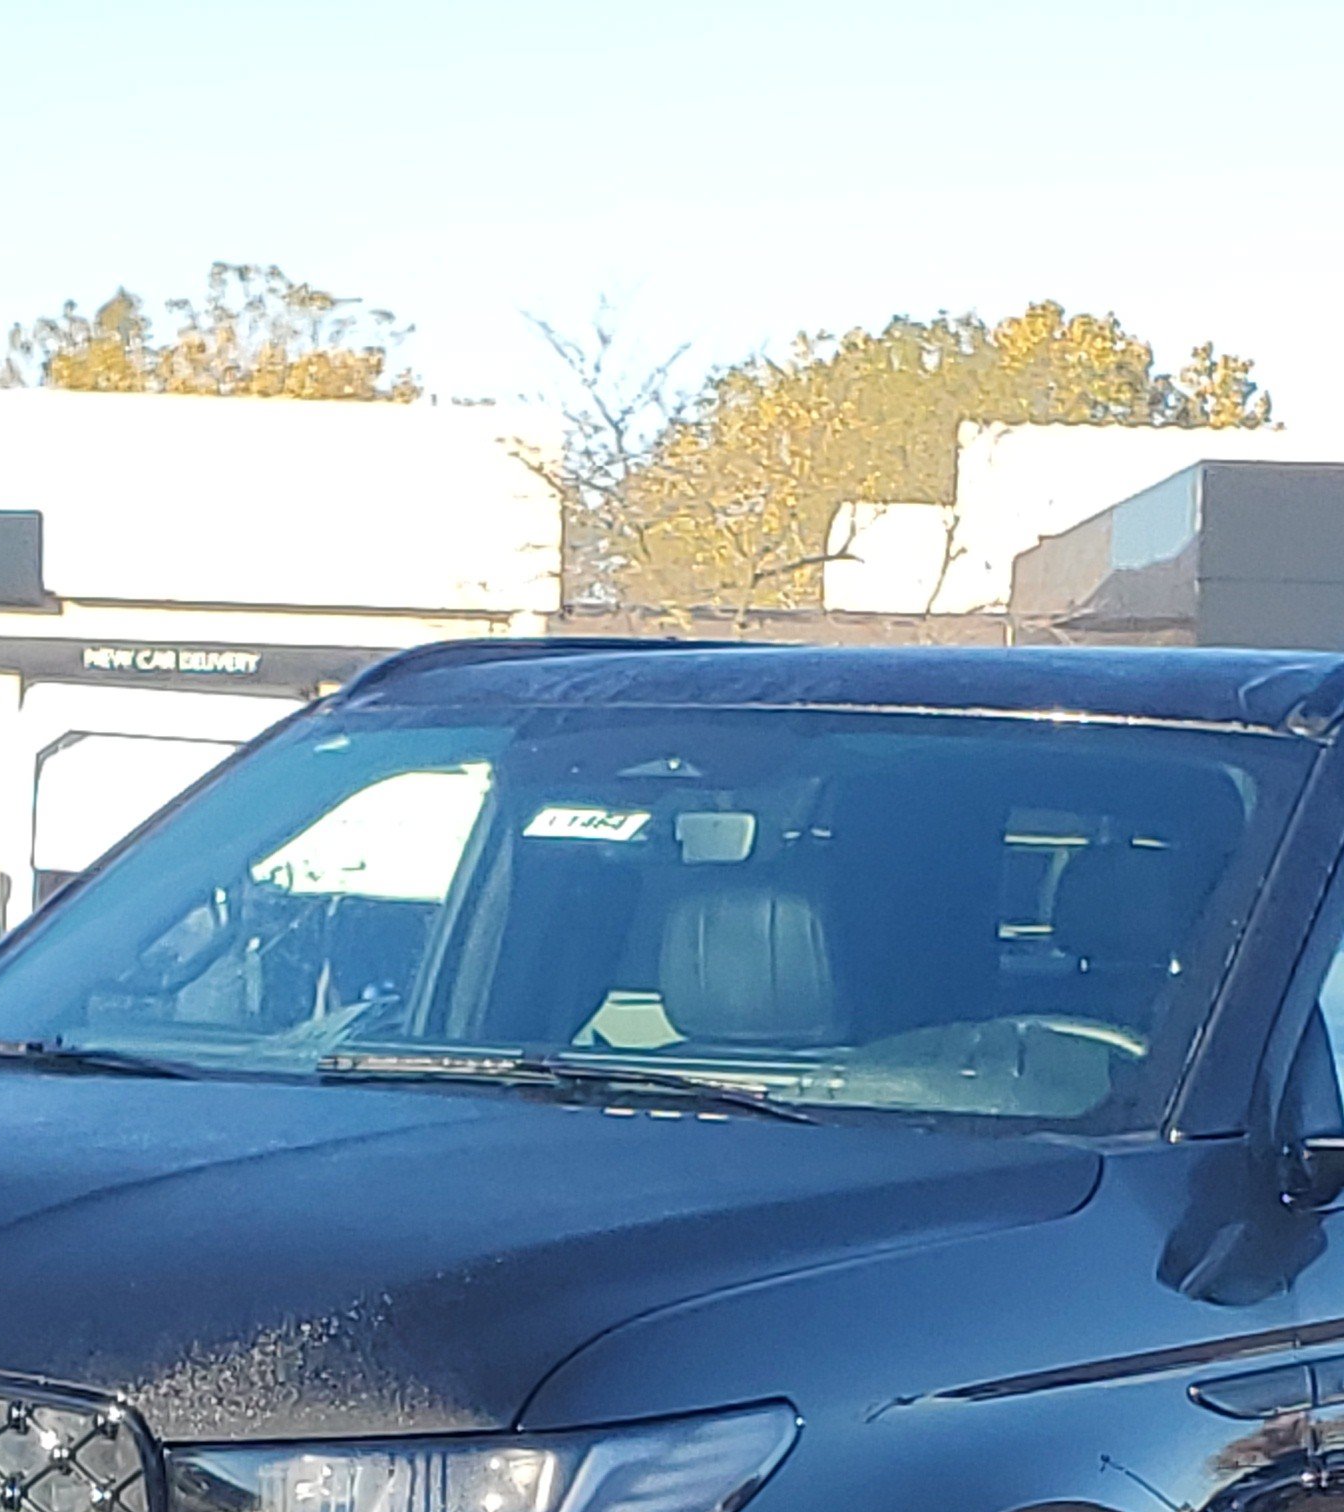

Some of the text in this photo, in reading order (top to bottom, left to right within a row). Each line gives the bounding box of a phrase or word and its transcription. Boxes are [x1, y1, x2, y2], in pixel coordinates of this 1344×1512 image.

[83, 647, 261, 674] NEW CAR DELIVERY
